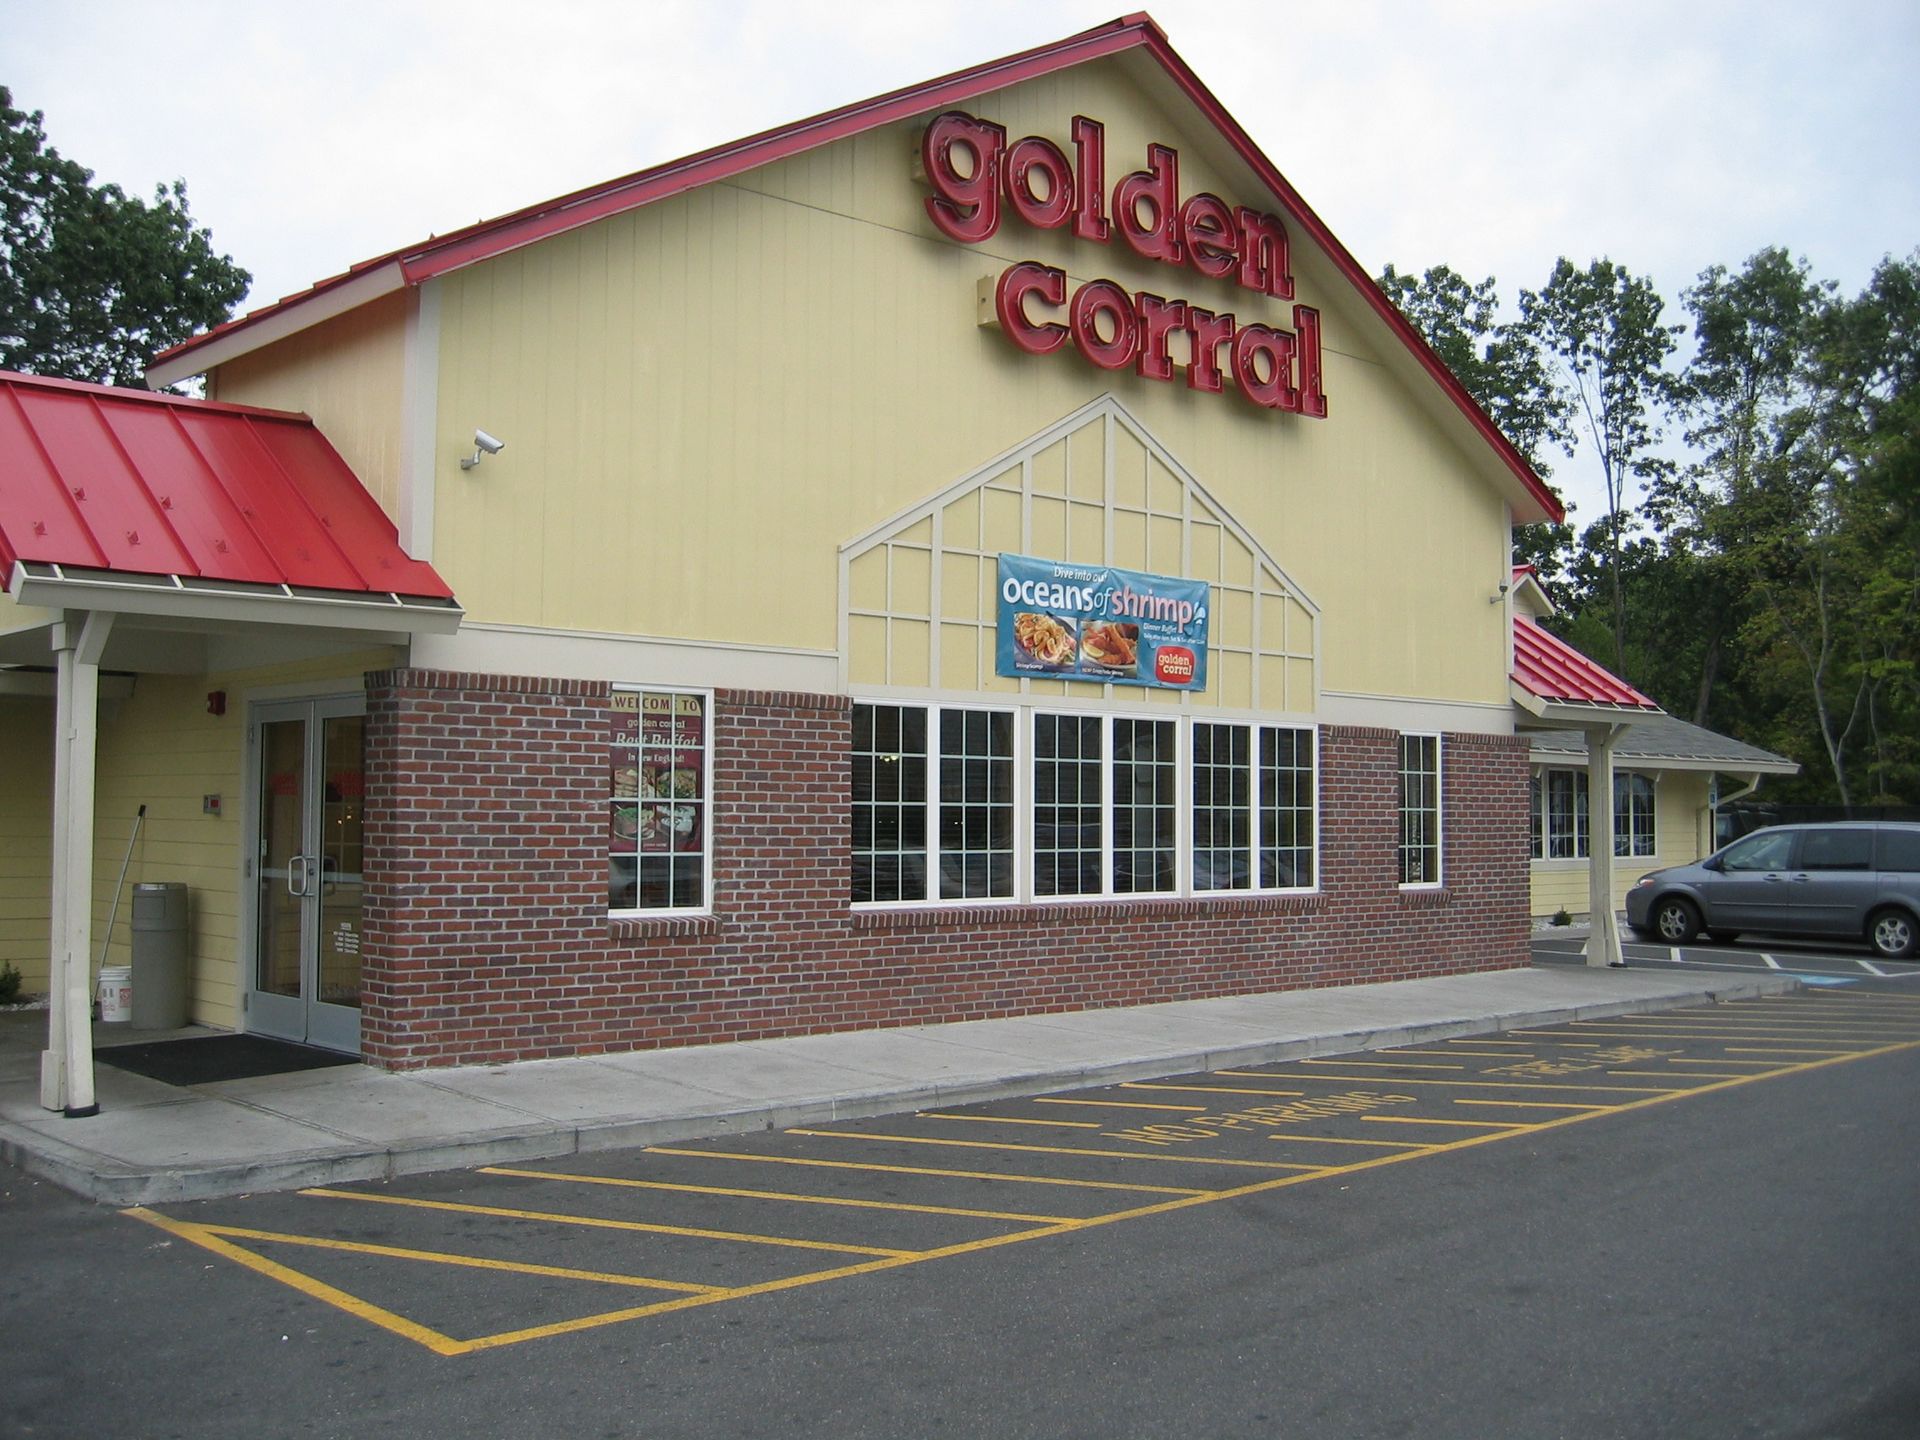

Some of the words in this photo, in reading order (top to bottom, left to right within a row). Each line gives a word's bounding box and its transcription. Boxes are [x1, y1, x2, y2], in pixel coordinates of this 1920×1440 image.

[922, 110, 1295, 301] golden
[996, 260, 1328, 419] corral
[1054, 566, 1074, 580] Dive
[1074, 568, 1092, 581] into
[1002, 577, 1094, 612] oceans
[1093, 587, 1112, 616] of
[1158, 653, 1190, 666] golden
[1162, 664, 1193, 676] corral
[682, 699, 698, 712] TO
[1100, 1124, 1219, 1146] NO
[1185, 1092, 1418, 1131] PARKING
